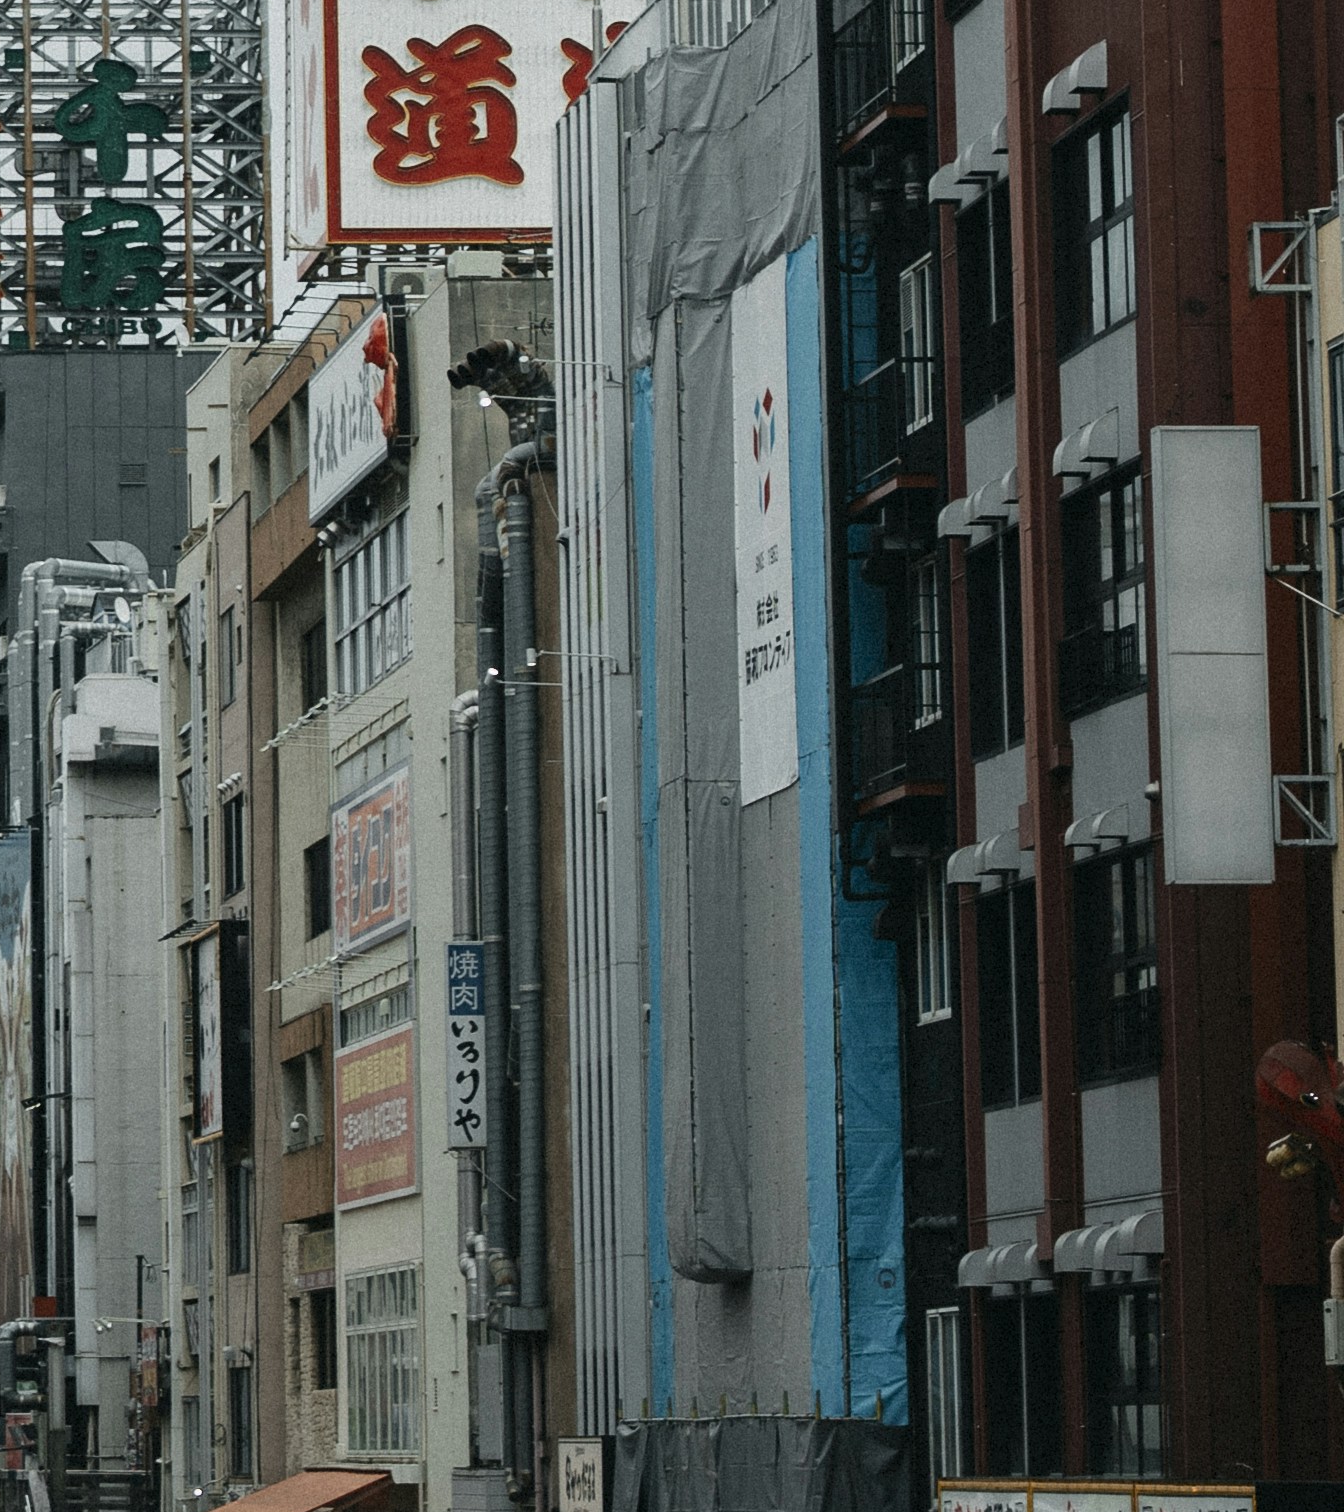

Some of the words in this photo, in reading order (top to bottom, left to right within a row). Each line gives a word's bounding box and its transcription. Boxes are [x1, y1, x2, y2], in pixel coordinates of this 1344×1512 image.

[360, 21, 630, 188] 道
[55, 59, 170, 310] 千房
[449, 950, 479, 1011] 焼肉
[450, 1020, 482, 1142] いろりや
